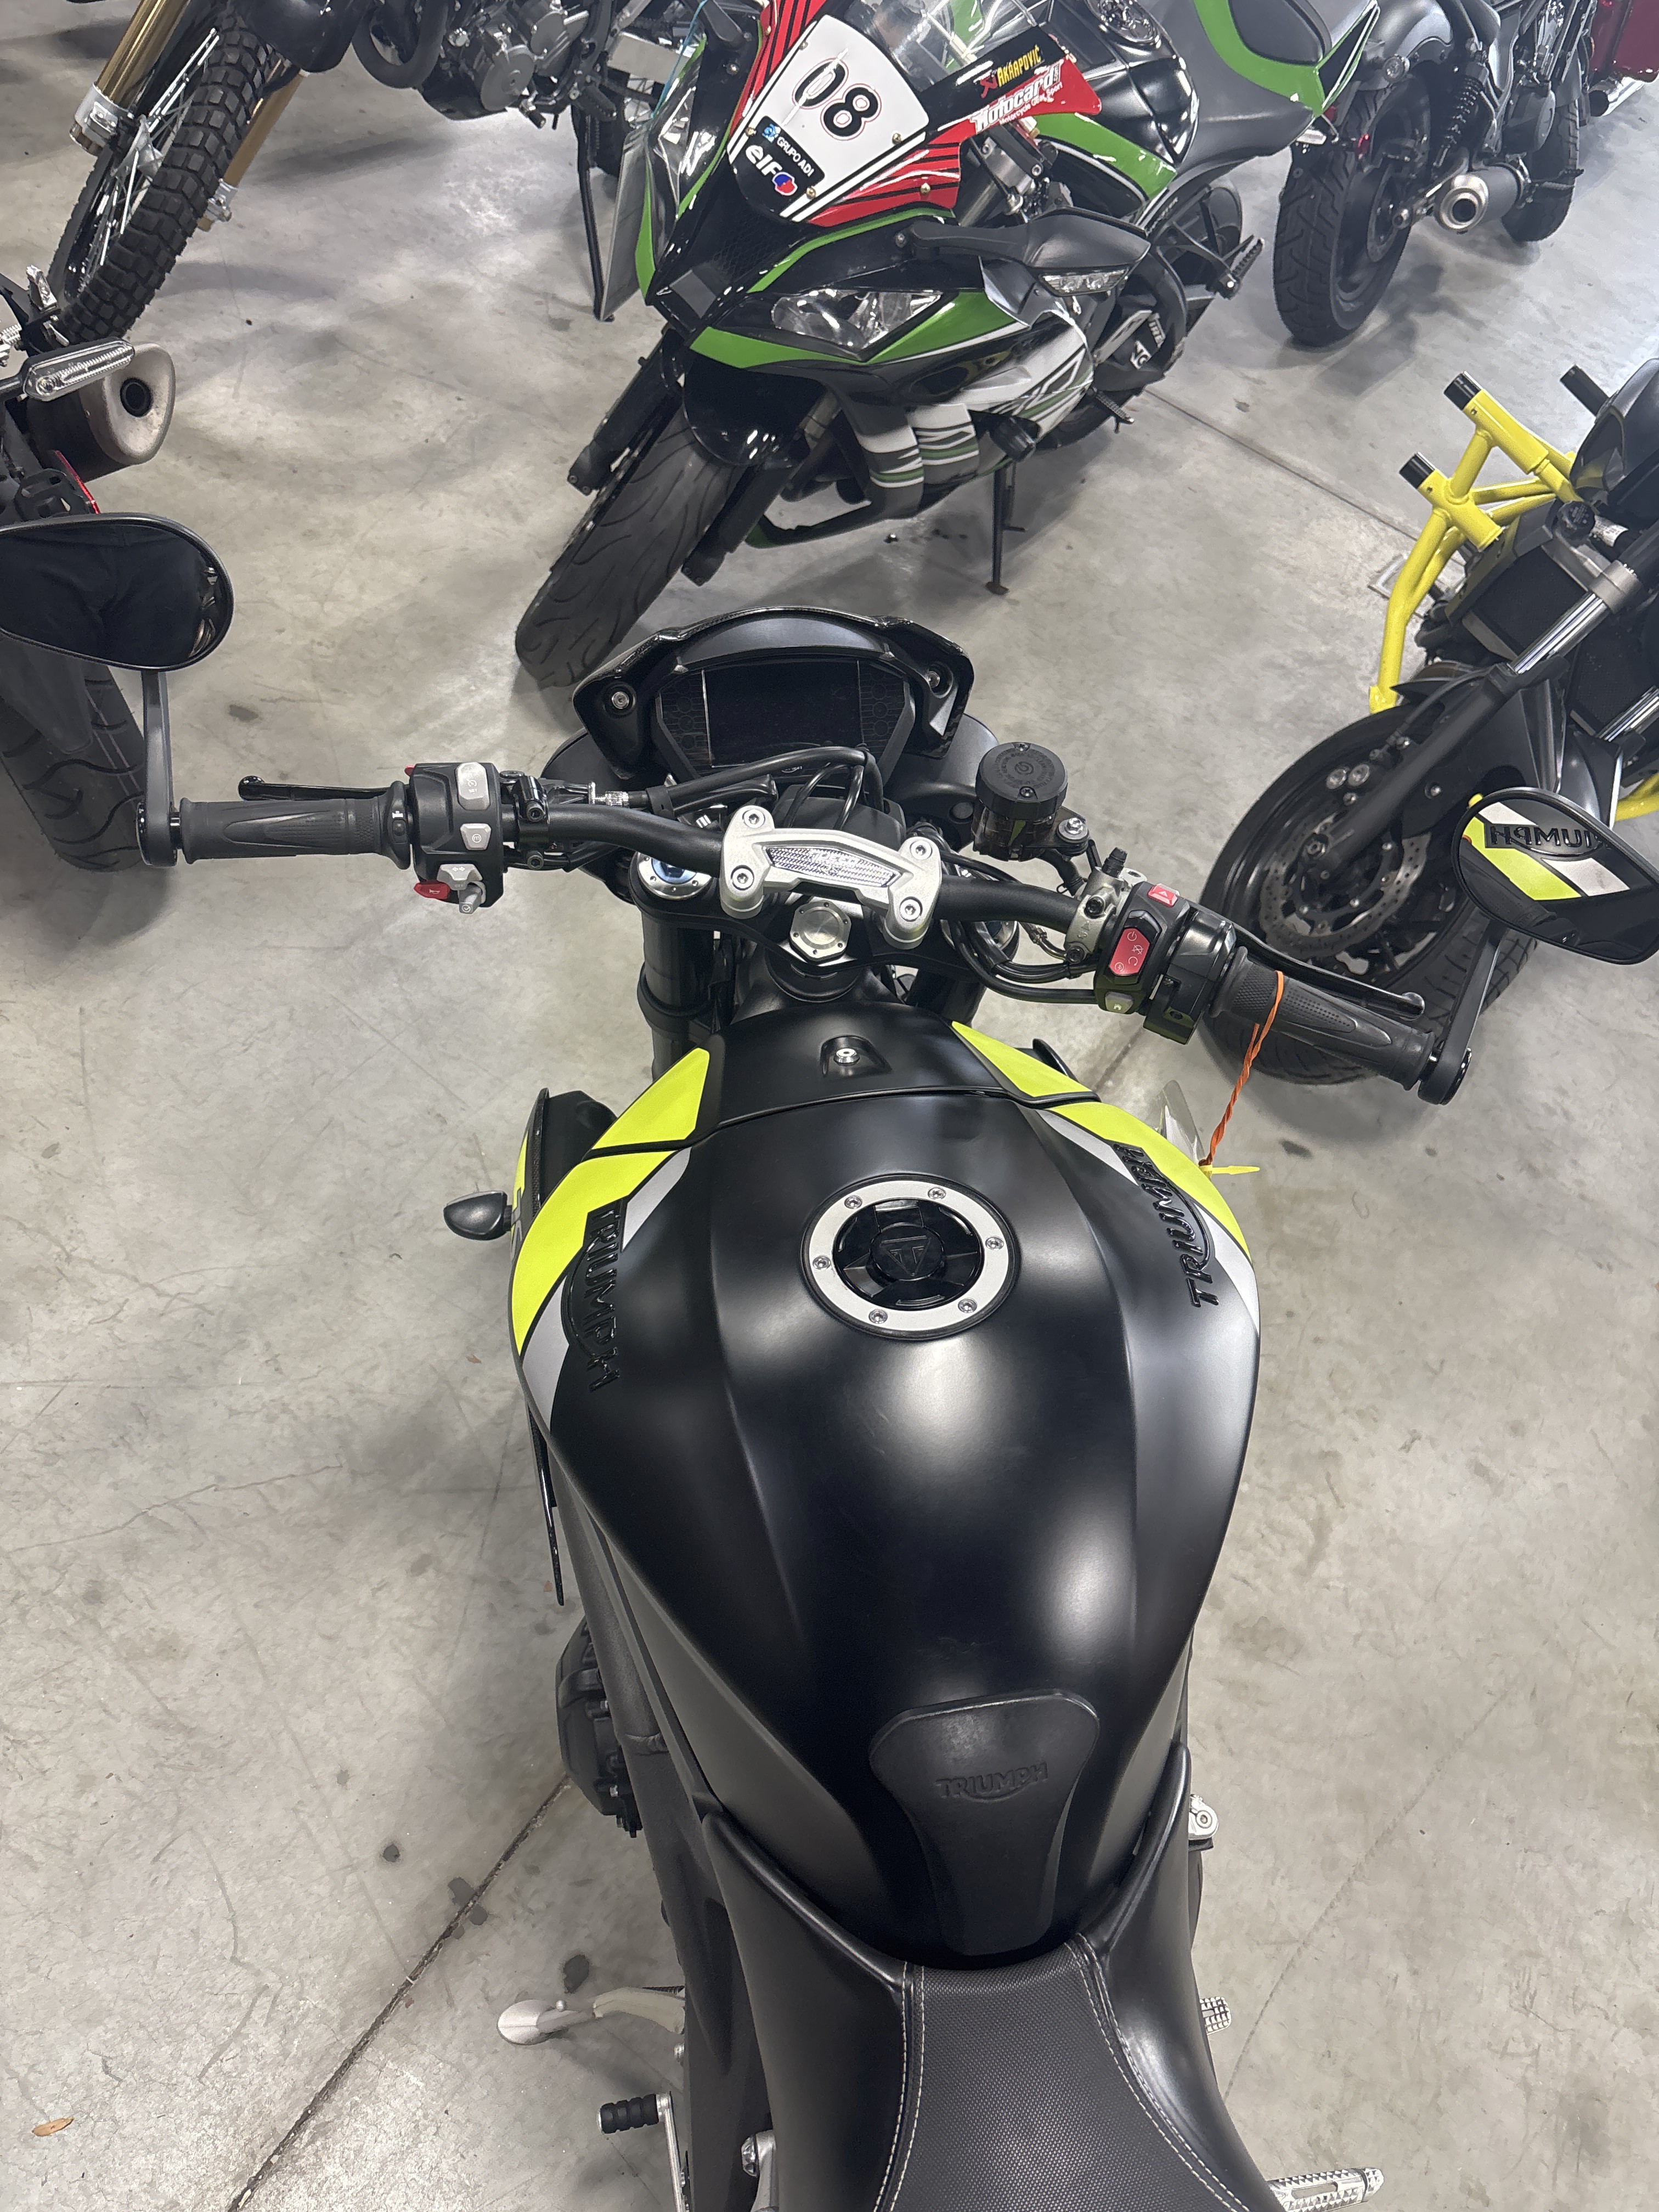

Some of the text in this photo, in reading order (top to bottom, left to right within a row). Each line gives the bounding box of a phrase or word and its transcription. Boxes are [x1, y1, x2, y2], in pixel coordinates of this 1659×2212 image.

[792, 58, 882, 140] 08
[745, 145, 783, 176] elf
[776, 137, 815, 178] GRUPO ADI
[1113, 1144, 1219, 1308] TRIUMPH
[584, 1200, 621, 1392] TRIUMPH
[935, 1762, 1048, 1799] TRIUMPH
